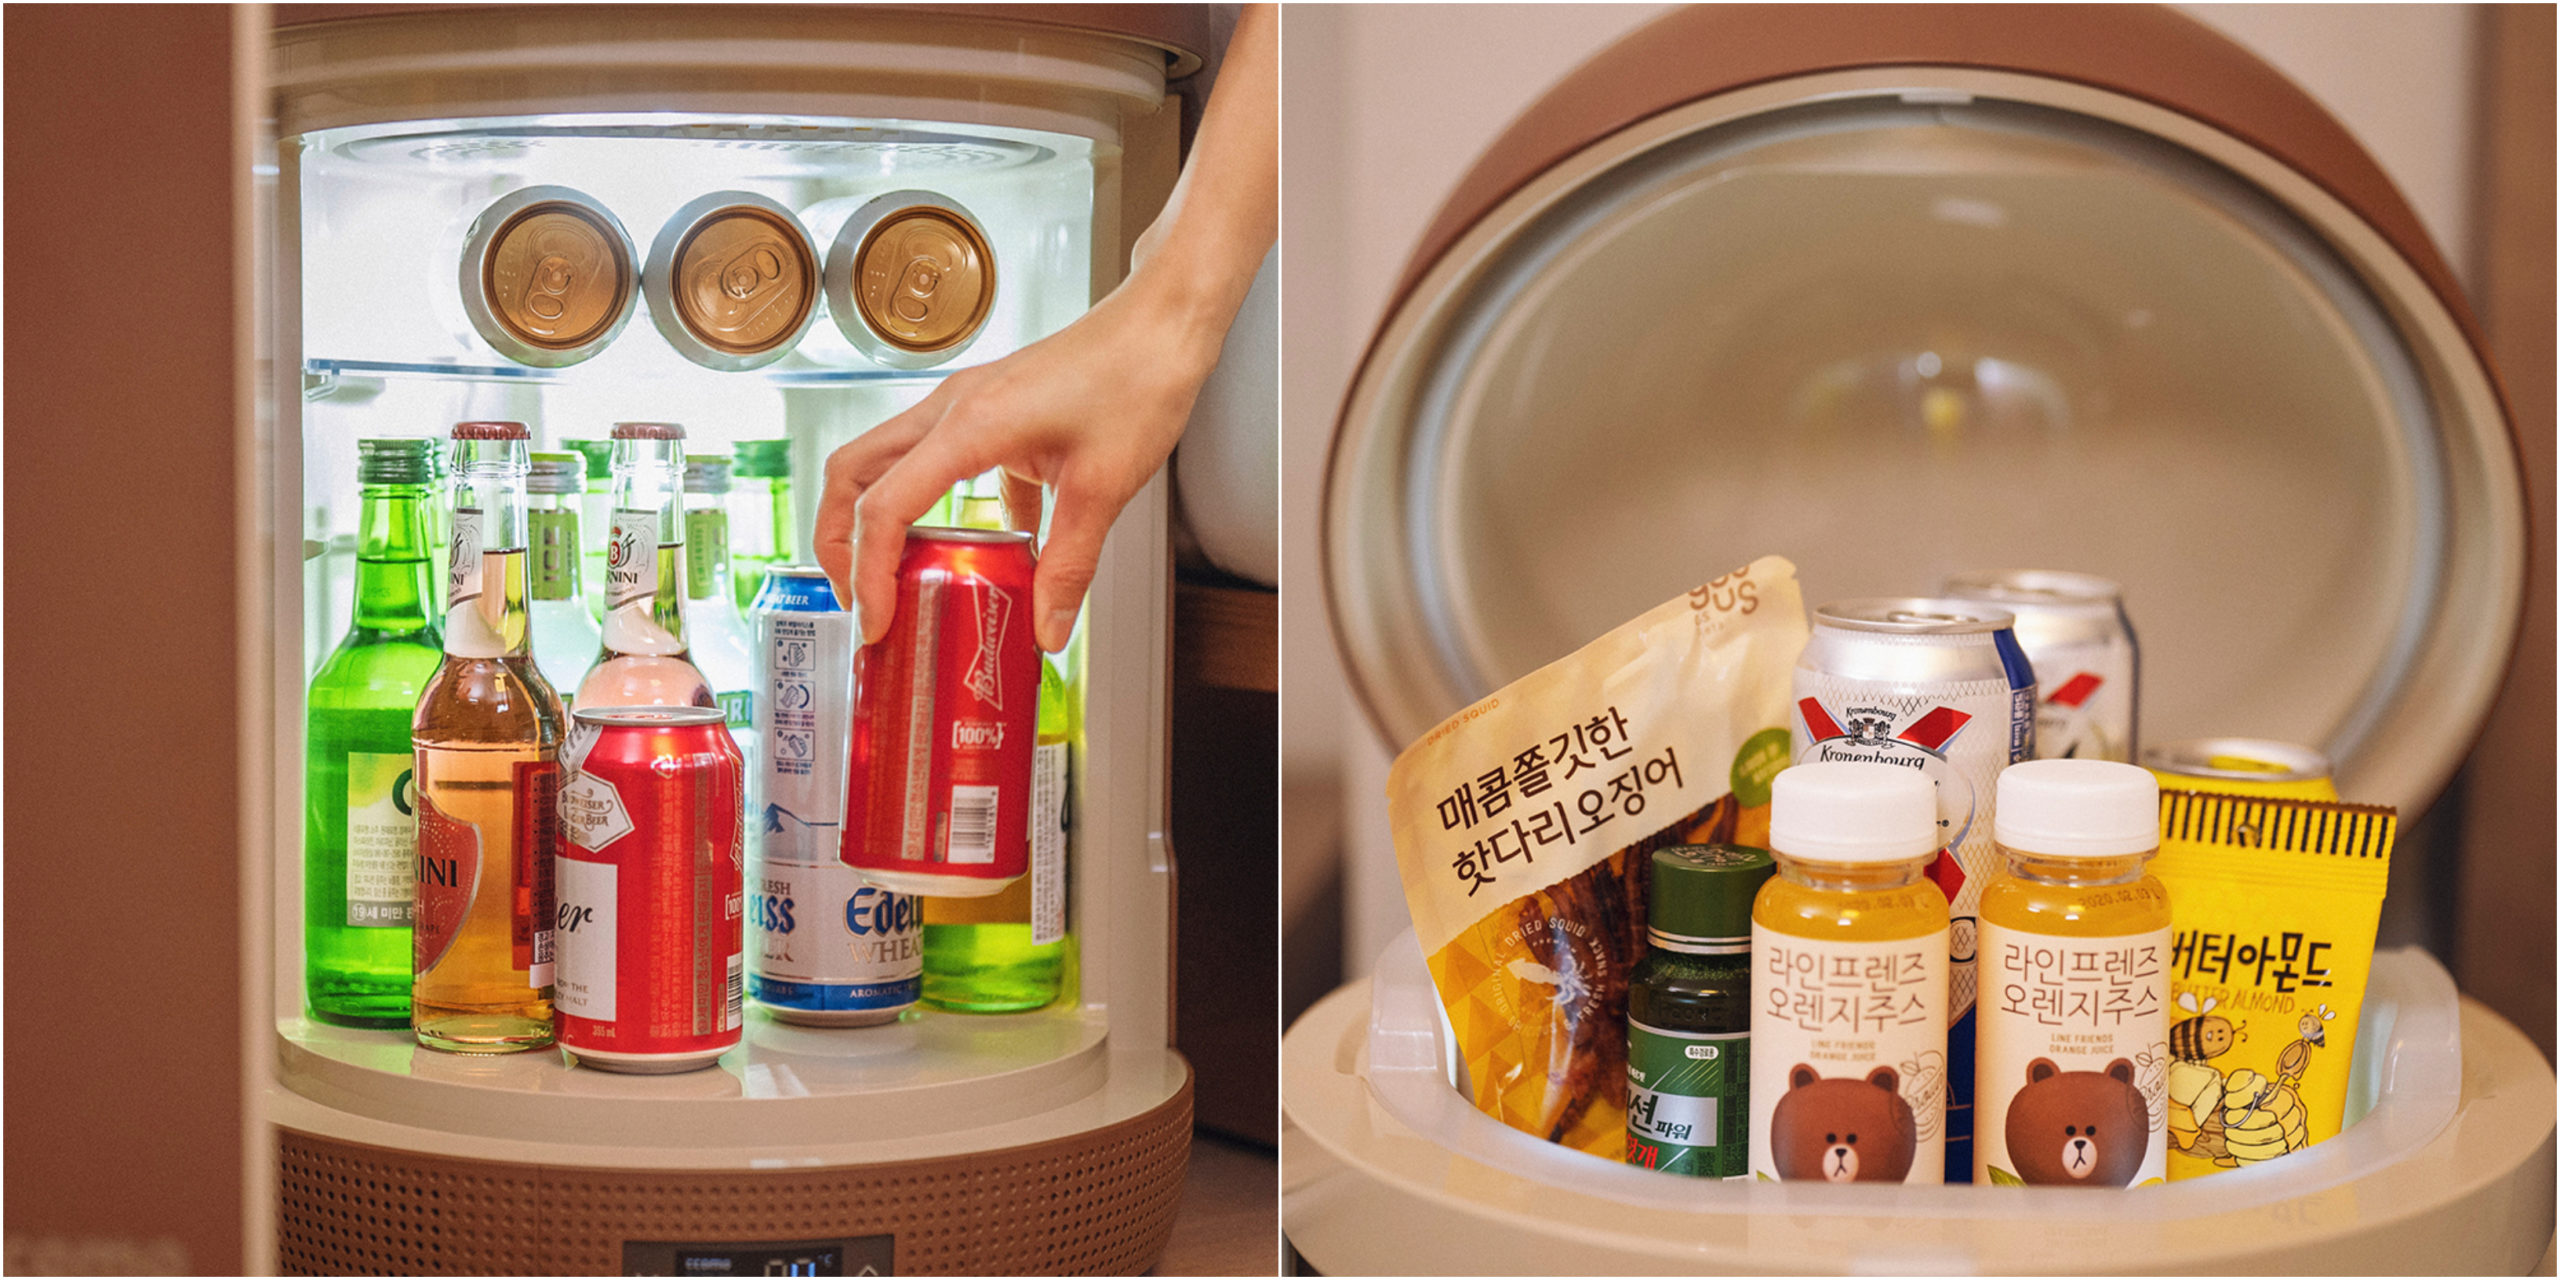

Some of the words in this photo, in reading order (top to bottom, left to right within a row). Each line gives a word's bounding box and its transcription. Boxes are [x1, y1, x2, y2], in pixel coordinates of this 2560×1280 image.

[973, 584, 1000, 700] Budweiser
[1427, 719, 1460, 747] DRIED
[1463, 697, 1500, 724] SQUID
[1846, 705, 1897, 722] Kronenbourg
[1436, 706, 1633, 832] 매콤쫄깃한
[1451, 746, 1685, 898] 핫다리오징어
[380, 907, 403, 920] 미만
[1504, 919, 1543, 948] DRIED
[1548, 916, 1587, 938] SQUID
[1769, 947, 1927, 993] 라인프렌즈
[2004, 945, 2160, 987] 라인프렌즈
[2171, 929, 2333, 994] 버터아몬드
[1766, 987, 1928, 1034] 오렌지주스
[2001, 984, 2160, 1027] 오렌지주스
[2230, 989, 2297, 1016] ALMOND
[2049, 1044, 2087, 1055] ORANGE
[2091, 1044, 2114, 1055] JUICE
[2050, 1033, 2071, 1043] LINE
[2074, 1033, 2114, 1044] FRIENDS
[1655, 1119, 1693, 1141] 파워
